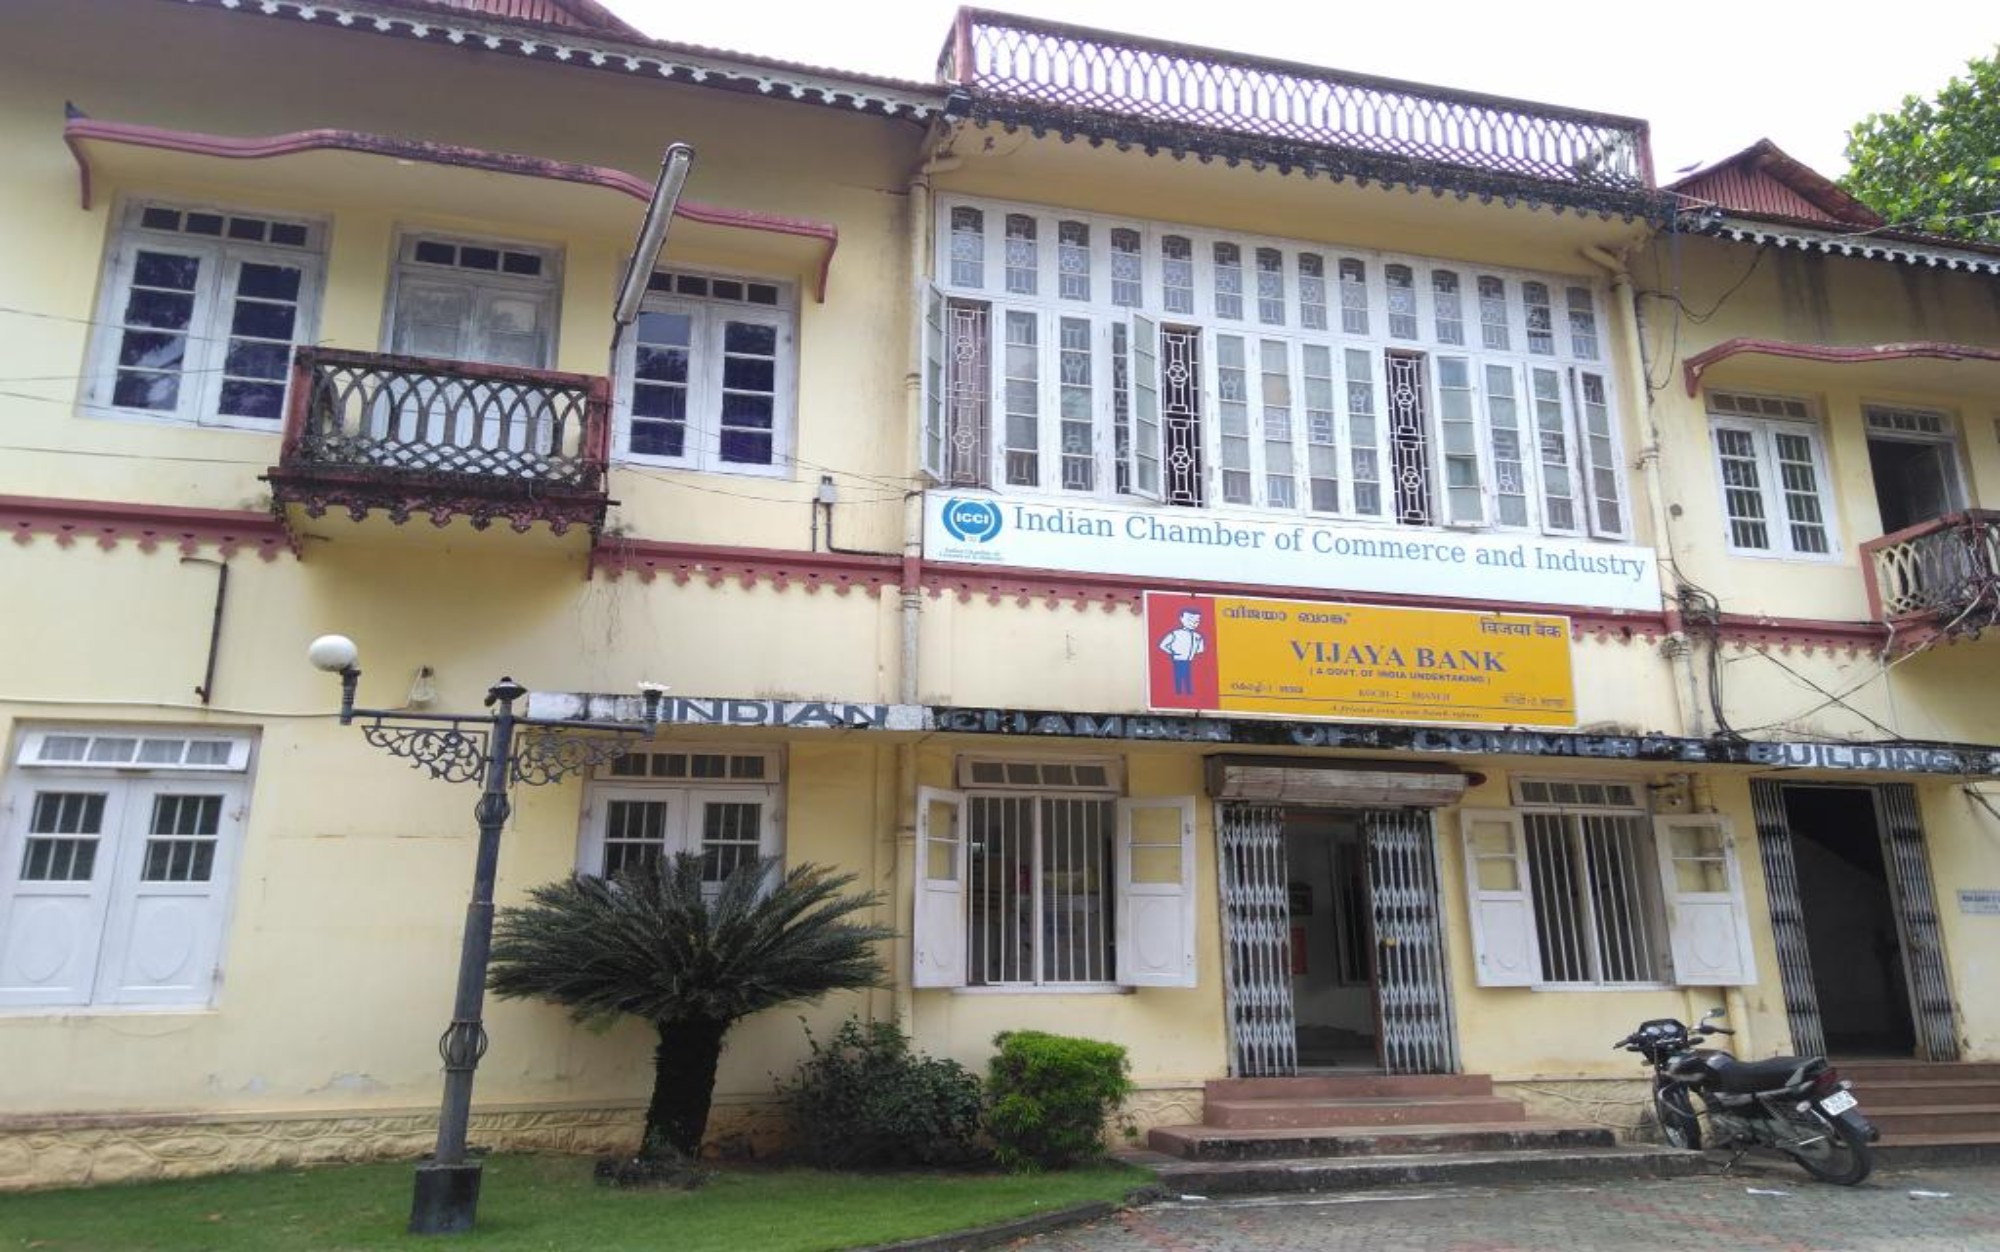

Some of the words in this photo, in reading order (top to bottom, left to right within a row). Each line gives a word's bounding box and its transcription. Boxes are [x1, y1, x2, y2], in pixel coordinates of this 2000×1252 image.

[956, 512, 989, 525] ICCI
[1014, 505, 1116, 537] Indian
[1125, 515, 1266, 548] Chamber
[1274, 528, 1304, 551] of
[1312, 530, 1466, 563] Commerce
[1475, 545, 1526, 568] and
[1536, 547, 1646, 581] Industry
[1291, 640, 1406, 668] VIJAYA
[1416, 647, 1507, 672] BANK
[1361, 669, 1373, 678] OF
[1378, 670, 1407, 680] INDIA
[661, 698, 888, 729] INDIAN
[1749, 742, 1952, 773] BUILDING
